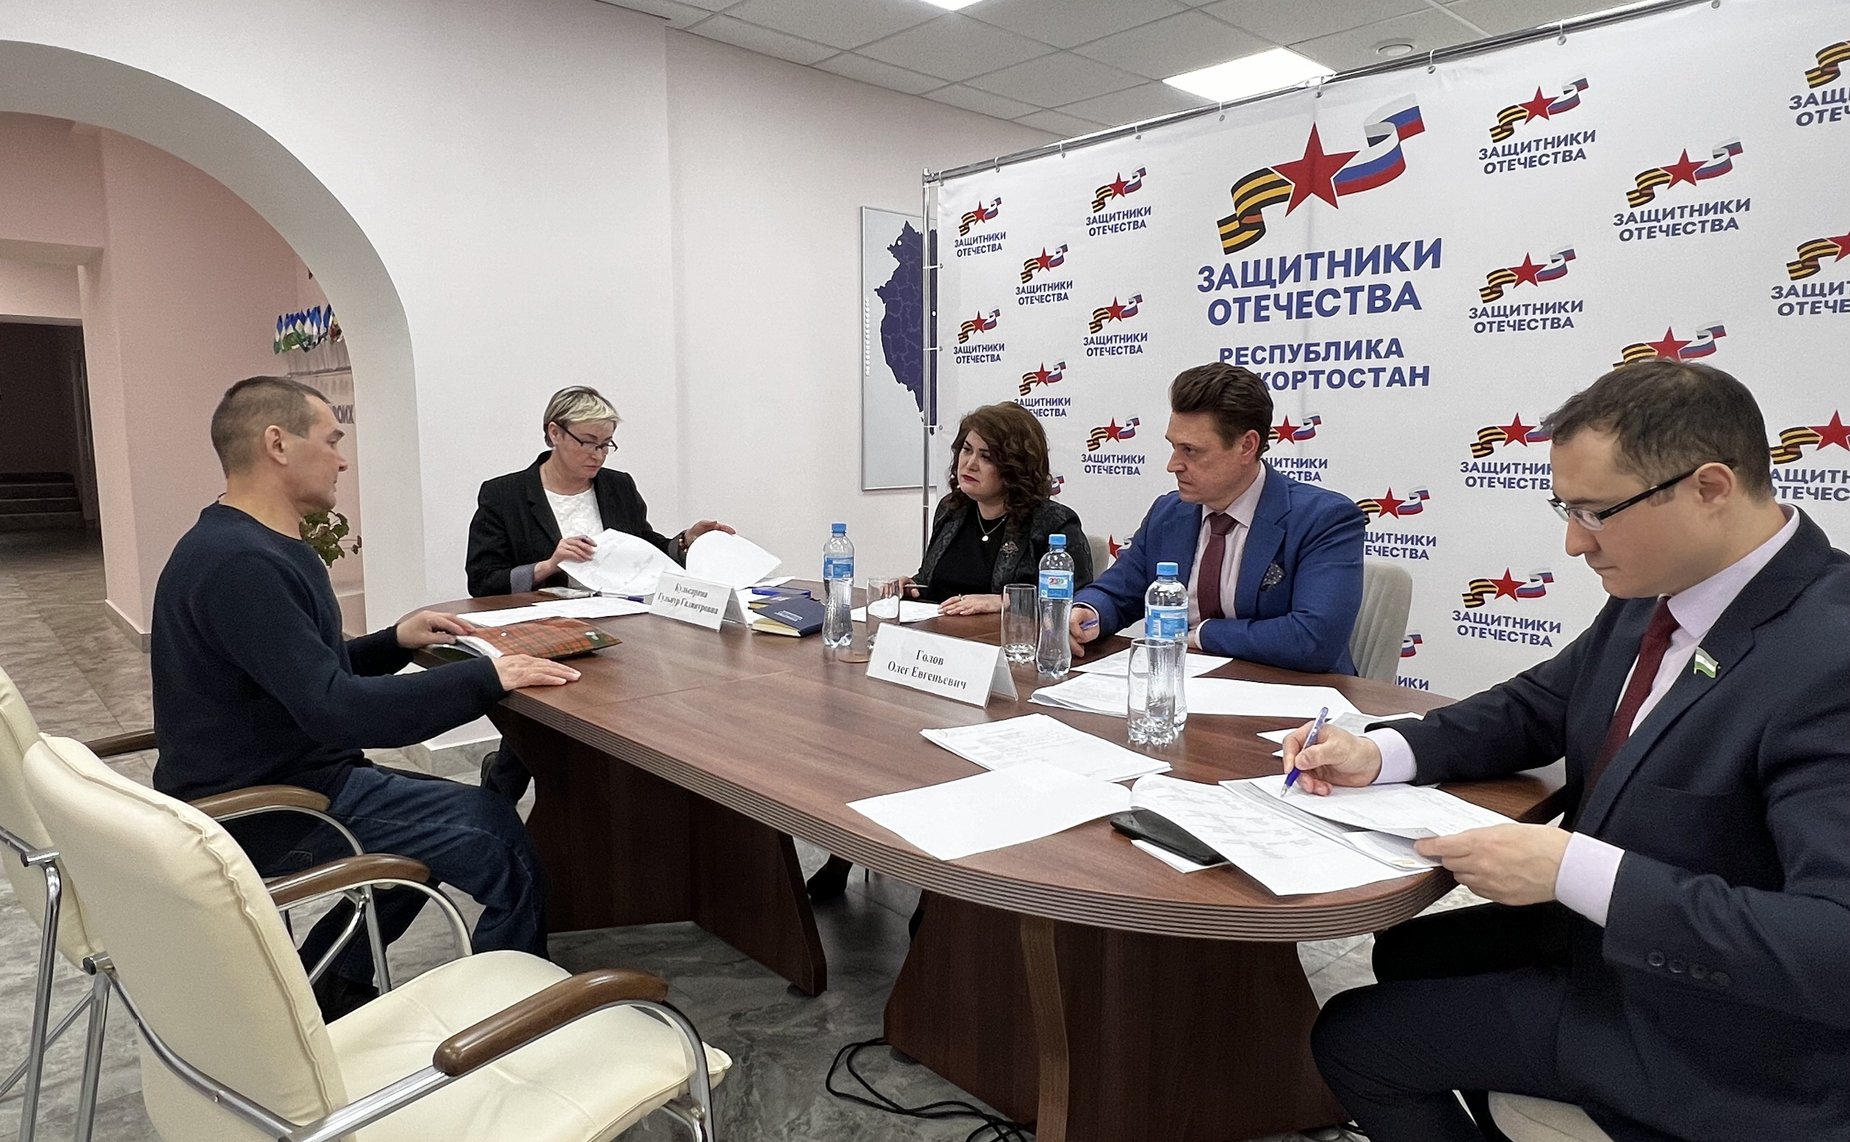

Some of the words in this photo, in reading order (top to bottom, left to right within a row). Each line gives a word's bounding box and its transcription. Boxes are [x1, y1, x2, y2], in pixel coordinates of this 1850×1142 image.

[1478, 129, 1597, 161] ЗАЩИТНИКИ
[1483, 148, 1587, 175] ОТЕЧЕСТВА
[1086, 205, 1151, 227] ЗАЩИТНИКИ
[1613, 197, 1751, 227] ЗАЩИТНИКИ
[1088, 221, 1147, 237] ОТЕЧЕСТВА
[1618, 217, 1739, 242] ОТЕЧЕСТВА
[954, 231, 1006, 249] ЗАЩИТНИКИ
[956, 243, 1002, 258] ОТЕЧЕСТВА
[1197, 237, 1443, 293] ЗАЩИТНИКИ
[1015, 280, 1073, 296] ЗАЩИТНИКИ
[1018, 292, 1069, 306] ОТЕЧЕСТВА
[1207, 280, 1423, 327] ОТЕЧЕСТВА
[1777, 298, 1850, 317] ОТЕЧЕ
[1468, 299, 1584, 319] ЗАЩИТНИКИ
[1473, 316, 1575, 333] ОТЕЧЕСТВА
[1083, 332, 1148, 347] ЗАЩИТНИКИ
[953, 343, 1005, 355] ЗАЩИТНИКИ
[1086, 345, 1144, 357] ОТЕЧЕСТВА
[1219, 337, 1405, 366] РЕСПУБЛИКА
[955, 354, 1002, 365] ОТЕЧЕСТВА
[1256, 366, 1431, 391] КОРТОСТАН
[1029, 408, 1067, 417] ЧЕСТВА
[1081, 453, 1145, 464] ЗАЩИТНИКИ
[1084, 464, 1141, 476] ОТЕЧЕСТВА
[1460, 461, 1551, 475] ЗАЩИТНИ
[1771, 468, 1850, 485] АЩИТН
[1465, 476, 1552, 490] ОТЕЧЕСТВ
[1772, 485, 1850, 502] ТЕЧЕС
[1364, 531, 1437, 547] ЩИТНИКИ
[1365, 545, 1429, 560] ЕЧЕСТВА
[1451, 610, 1562, 634] ЗАЩИТНИКИ
[1456, 624, 1553, 647] ОТЕЧЕСТВА
[915, 649, 945, 666] Голов
[887, 660, 910, 675] Олег
[911, 666, 967, 690] Евгеньевич
